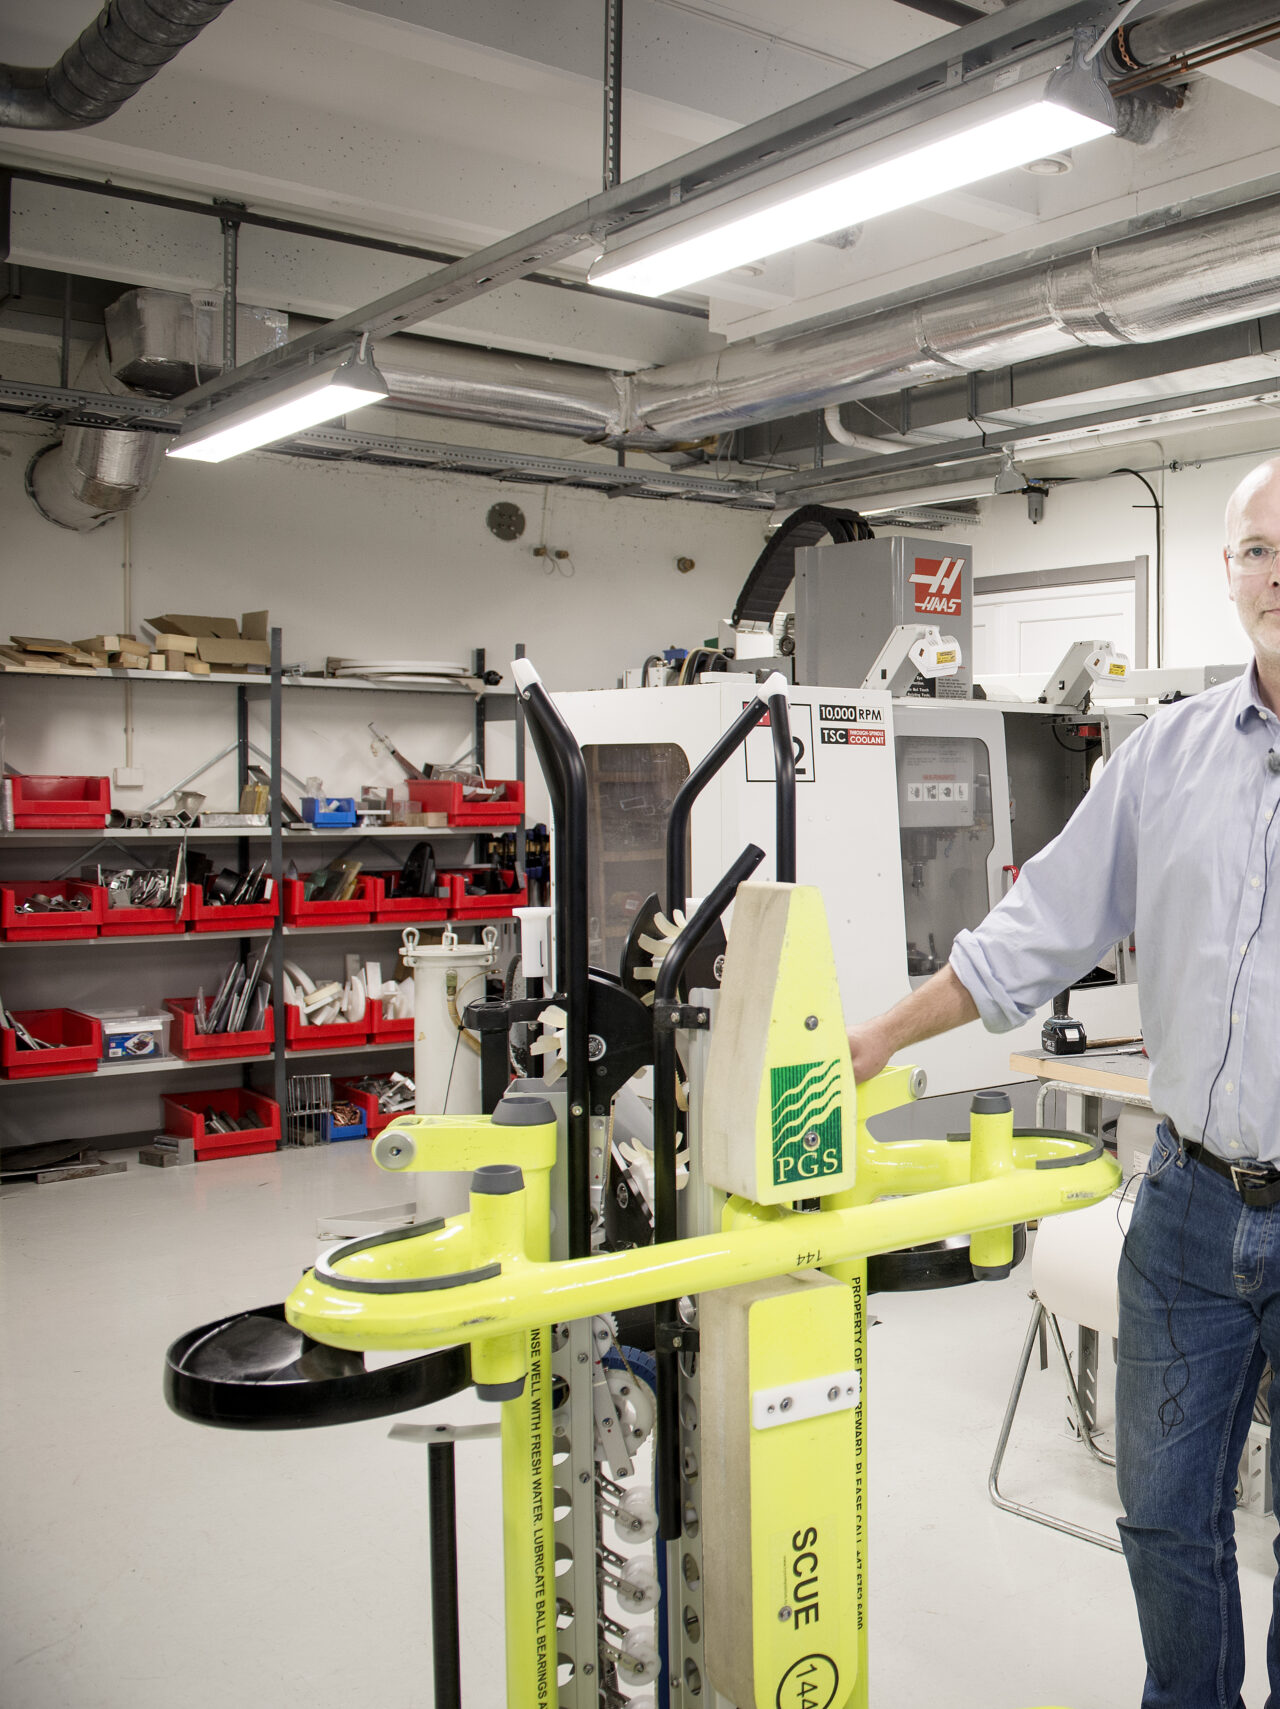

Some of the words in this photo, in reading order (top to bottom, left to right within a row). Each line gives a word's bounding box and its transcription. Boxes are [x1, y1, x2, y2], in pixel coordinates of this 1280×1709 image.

[915, 596, 961, 612] HAAS
[821, 706, 856, 720] 10,000
[859, 709, 882, 721] RPM
[822, 729, 846, 742] TSC
[850, 735, 884, 744] COOLANT
[776, 1148, 839, 1182] PGS
[796, 1249, 823, 1266] 144
[851, 1276, 862, 1344] PROPERTY
[530, 1328, 541, 1359] INSE
[854, 1347, 863, 1364] OF
[530, 1359, 541, 1397] WELL
[530, 1398, 541, 1432] WITH
[531, 1434, 542, 1477] FRESH
[532, 1477, 543, 1526] WATER.
[533, 1528, 545, 1599] LUBRICATE
[791, 1526, 819, 1631] SCUE
[535, 1600, 546, 1634] BALL
[536, 1635, 547, 1700] BEARINGS
